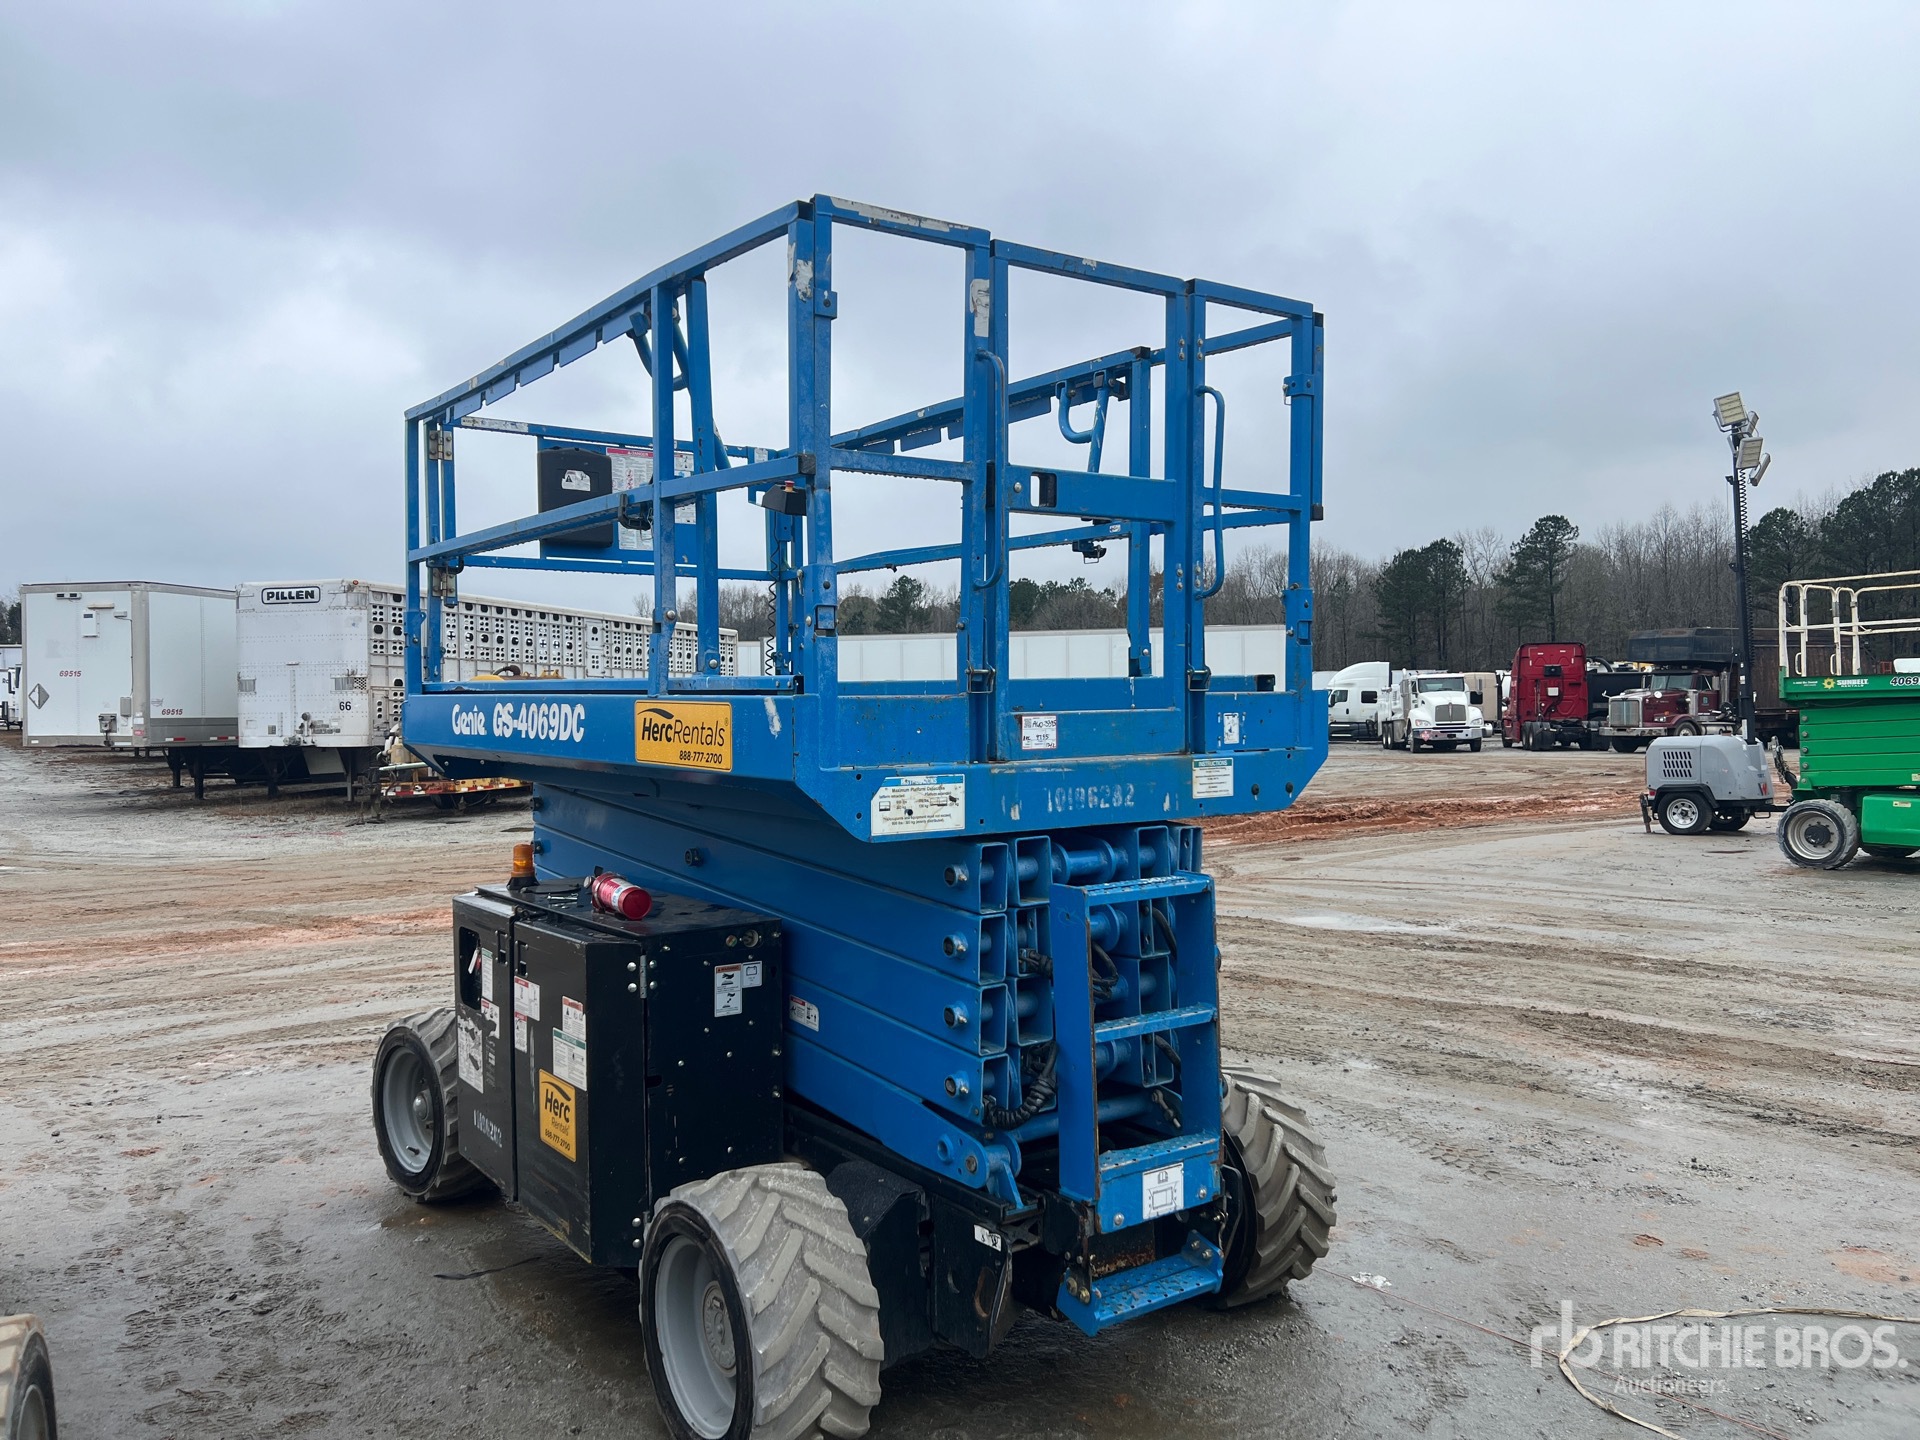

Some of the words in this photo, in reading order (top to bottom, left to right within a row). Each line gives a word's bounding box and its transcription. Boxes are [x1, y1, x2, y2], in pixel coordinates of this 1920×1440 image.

[266, 590, 315, 601] PILLEN
[339, 701, 352, 711] 66
[452, 704, 486, 735] Genie
[493, 702, 585, 742] GS-4069DC
[641, 717, 725, 747] HercRentals
[679, 750, 722, 764] 888-777-2700
[544, 1089, 571, 1123] Herc
